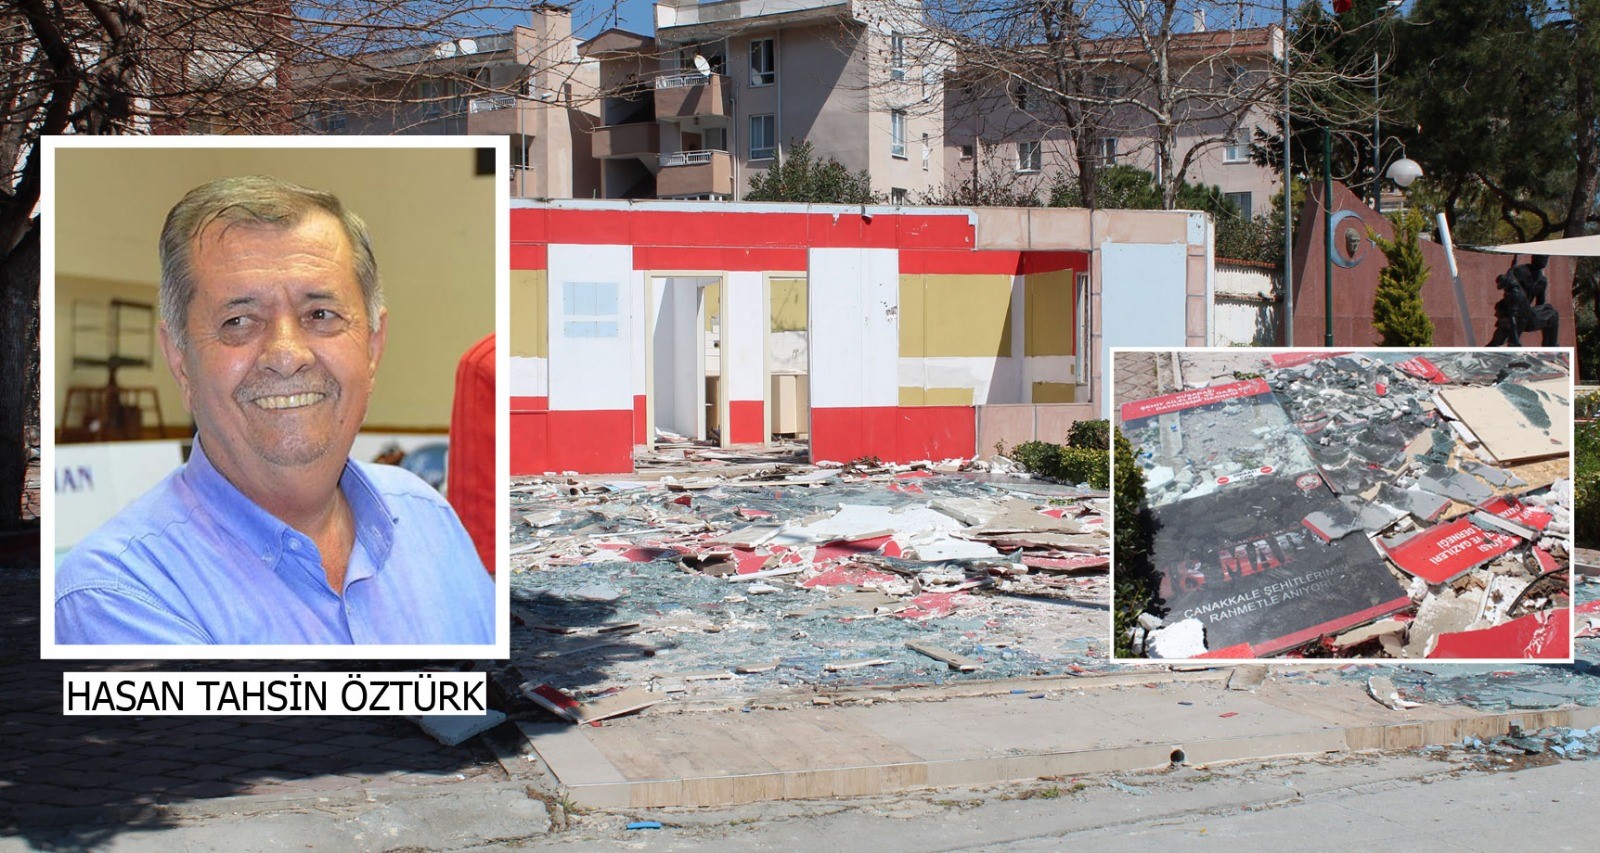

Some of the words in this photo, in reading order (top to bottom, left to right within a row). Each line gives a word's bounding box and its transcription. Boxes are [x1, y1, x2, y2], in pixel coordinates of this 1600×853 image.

[1437, 526, 1476, 548] DERNEĞİ
[1218, 531, 1310, 582] MAR
[1429, 538, 1473, 565] GAZİLERİ
[1184, 588, 1261, 619] ÇANAKKALE
[1210, 597, 1280, 623] RAHMETLE
